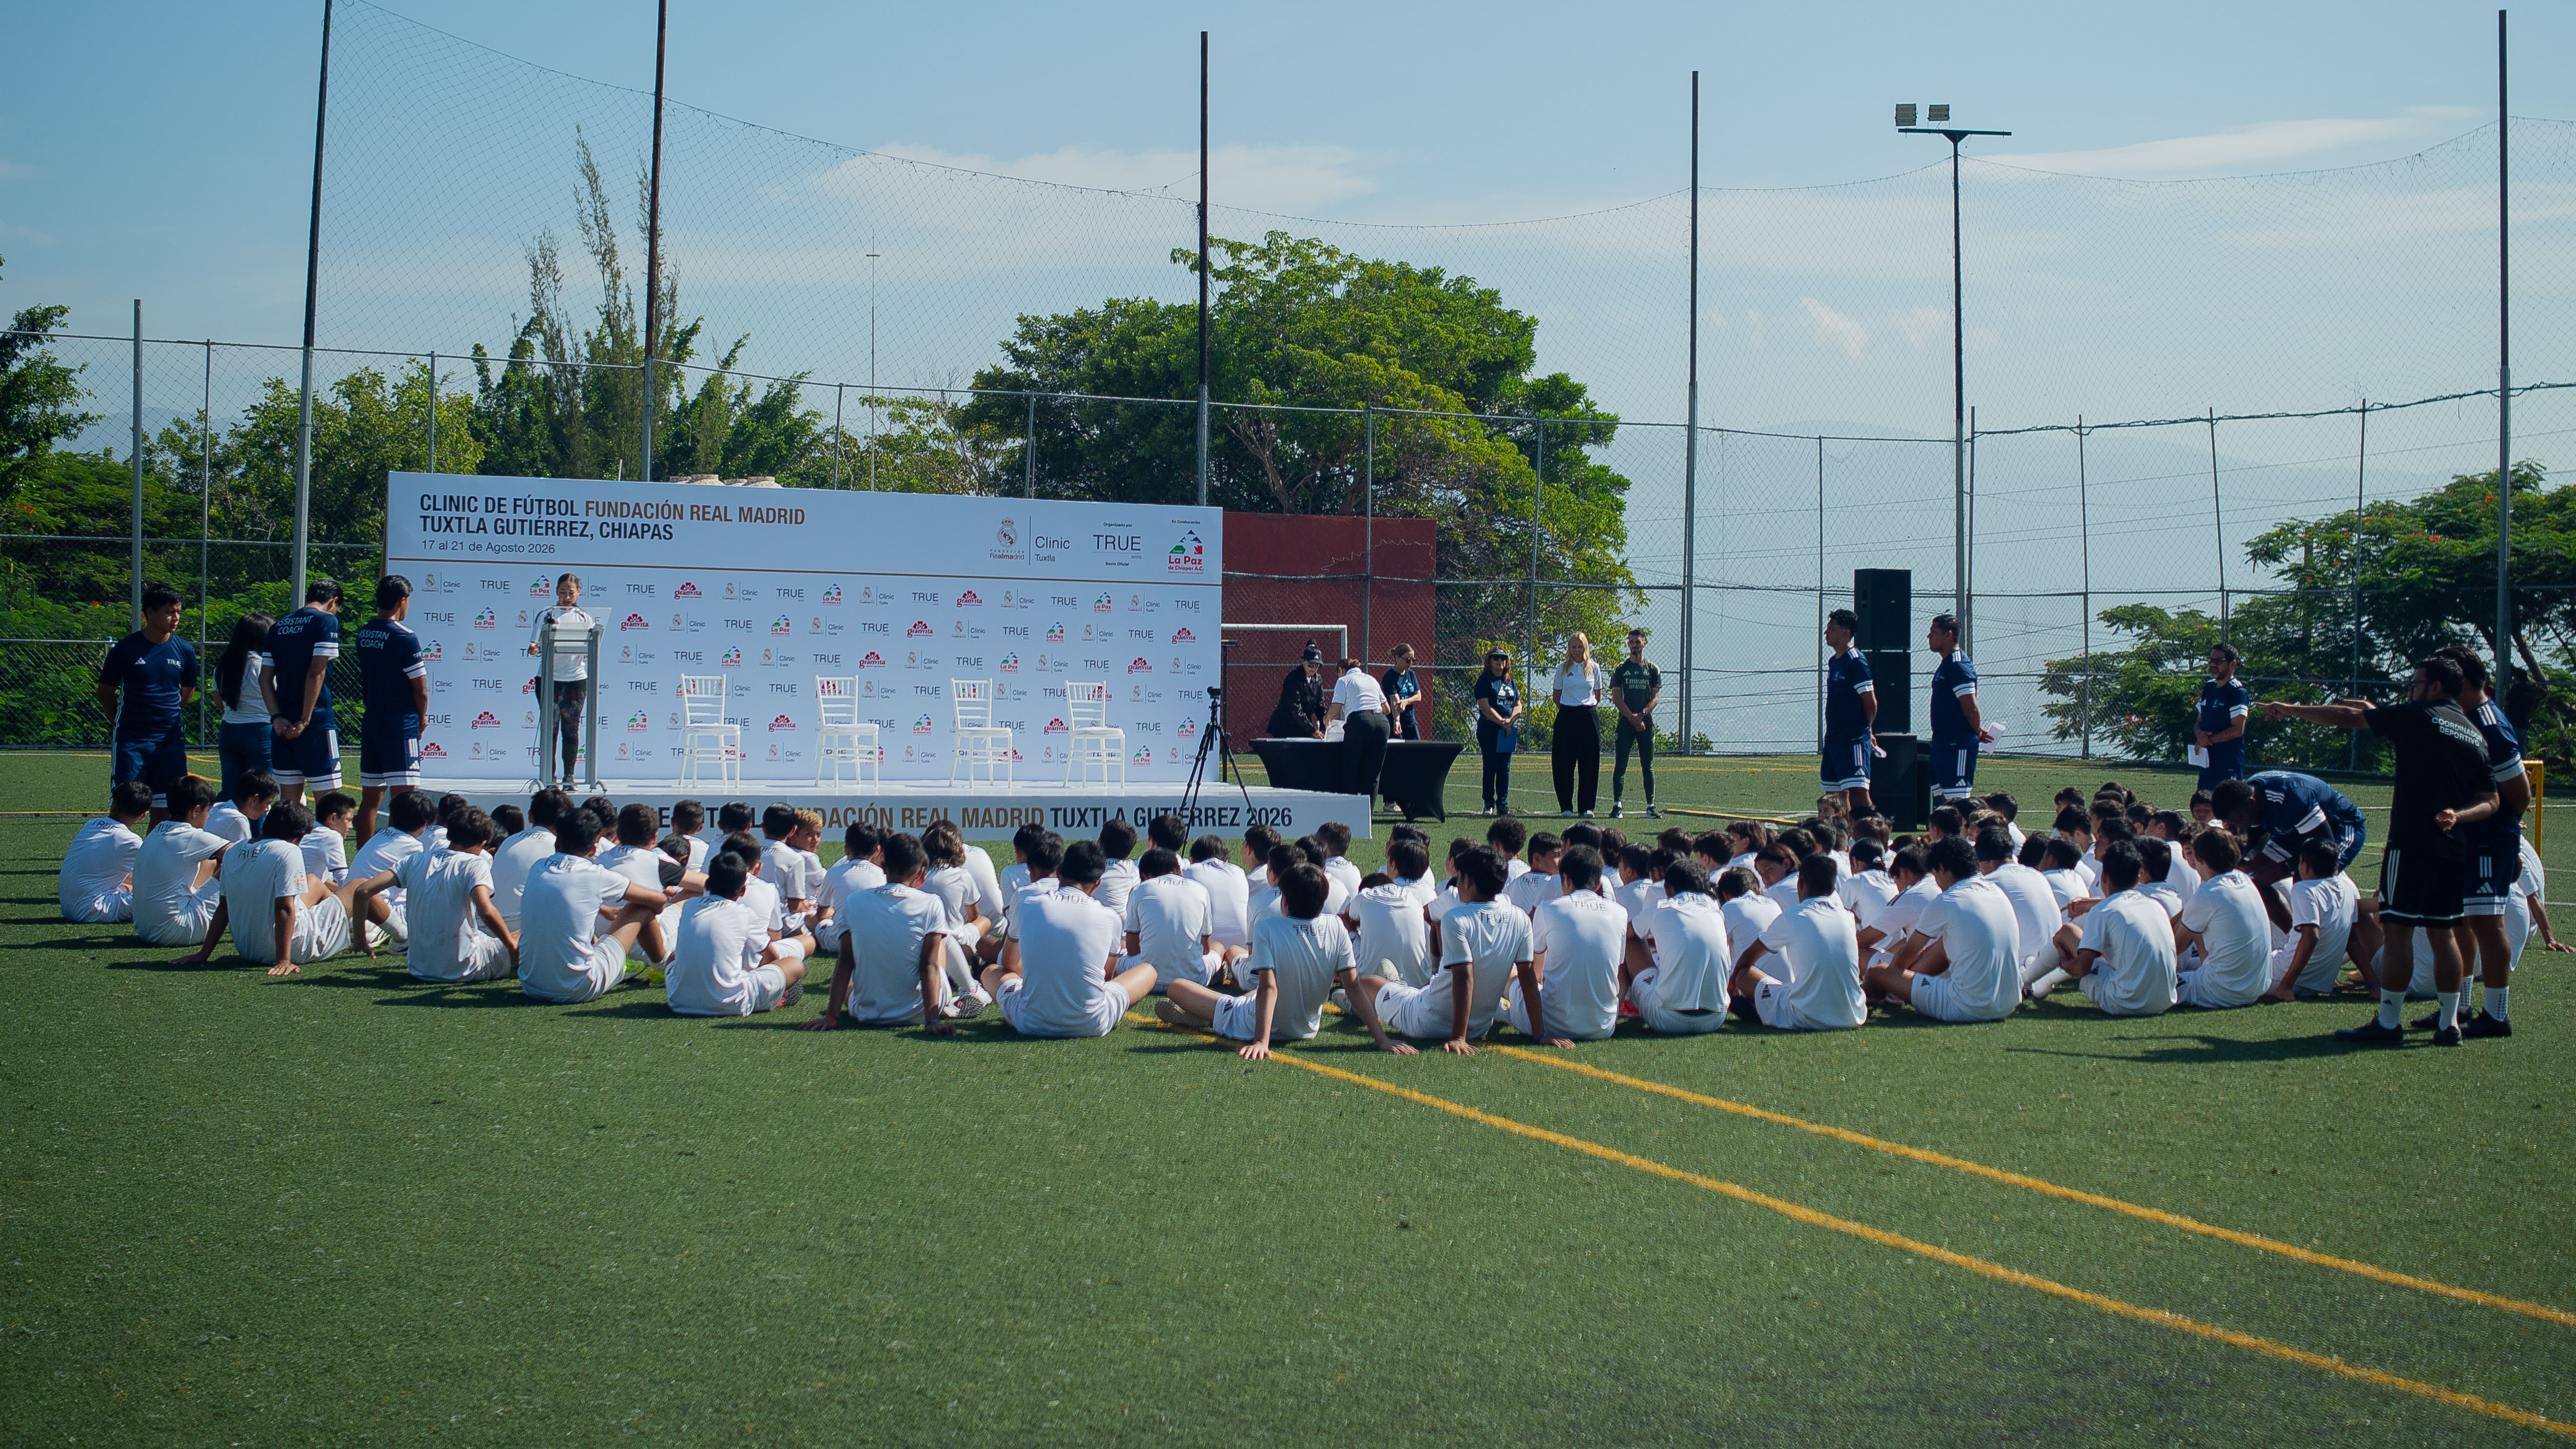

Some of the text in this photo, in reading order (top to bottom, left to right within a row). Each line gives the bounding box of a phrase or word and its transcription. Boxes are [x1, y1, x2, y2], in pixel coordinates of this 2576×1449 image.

[420, 494, 805, 525] CLINIC DE FÚTBOL FUNDACIÓN REAL MADRID
[420, 515, 673, 541] TUXTLA GUTIÉRREZ, CHIAPAS
[422, 540, 555, 554] 17 al 21 de Agosto 2026
[1035, 536, 1070, 549] Clinic
[1093, 535, 1141, 551] TRUE
[1169, 555, 1203, 565] La Paz
[480, 580, 510, 589] TRUE
[626, 584, 654, 593] TRUE
[674, 589, 702, 600] granvita
[776, 588, 804, 598] TRUE
[912, 592, 938, 601] TRUE
[957, 597, 982, 607] granvita
[1051, 597, 1077, 606] TRUE
[1175, 600, 1199, 609] TRUE
[277, 616, 314, 626] ASSISTANT
[423, 612, 454, 622] TRUE
[621, 619, 649, 631] granvita
[724, 620, 752, 628] TRUE
[862, 623, 889, 632] TRUE
[278, 626, 303, 634] COACH
[359, 630, 390, 640] SSISTAN
[907, 627, 933, 638] granvita
[1003, 627, 1029, 635] TRUE
[1129, 630, 1153, 638] TRUE
[1172, 633, 1196, 644] granvita
[360, 639, 384, 649] COACH
[674, 651, 702, 660] TRUE
[813, 654, 840, 663] TRUE
[859, 658, 886, 669] granvita
[956, 657, 982, 666] TRUE
[1084, 660, 1109, 668] TRUE
[1128, 663, 1152, 674] granvita
[472, 679, 502, 688] TRUE
[628, 682, 657, 690] TRUE
[769, 684, 797, 692] TRUE
[914, 686, 940, 695] TRUE
[1043, 688, 1066, 697] TRUE
[1178, 690, 1203, 699] TRUE
[472, 718, 501, 729] granvita
[769, 721, 795, 732] granvita
[999, 721, 1025, 730] TRUE
[1136, 723, 1161, 731] TRUE
[1044, 724, 1069, 735] granvita
[2432, 717, 2482, 742] COORDINADOR
[2439, 726, 2479, 746] DEPORTIVO
[792, 802, 893, 828] DACIÓN
[962, 807, 1044, 828] MADRID
[1247, 807, 1292, 827] 2026
[1480, 912, 1508, 923] TRUE
[1292, 924, 1324, 936] TRUE
